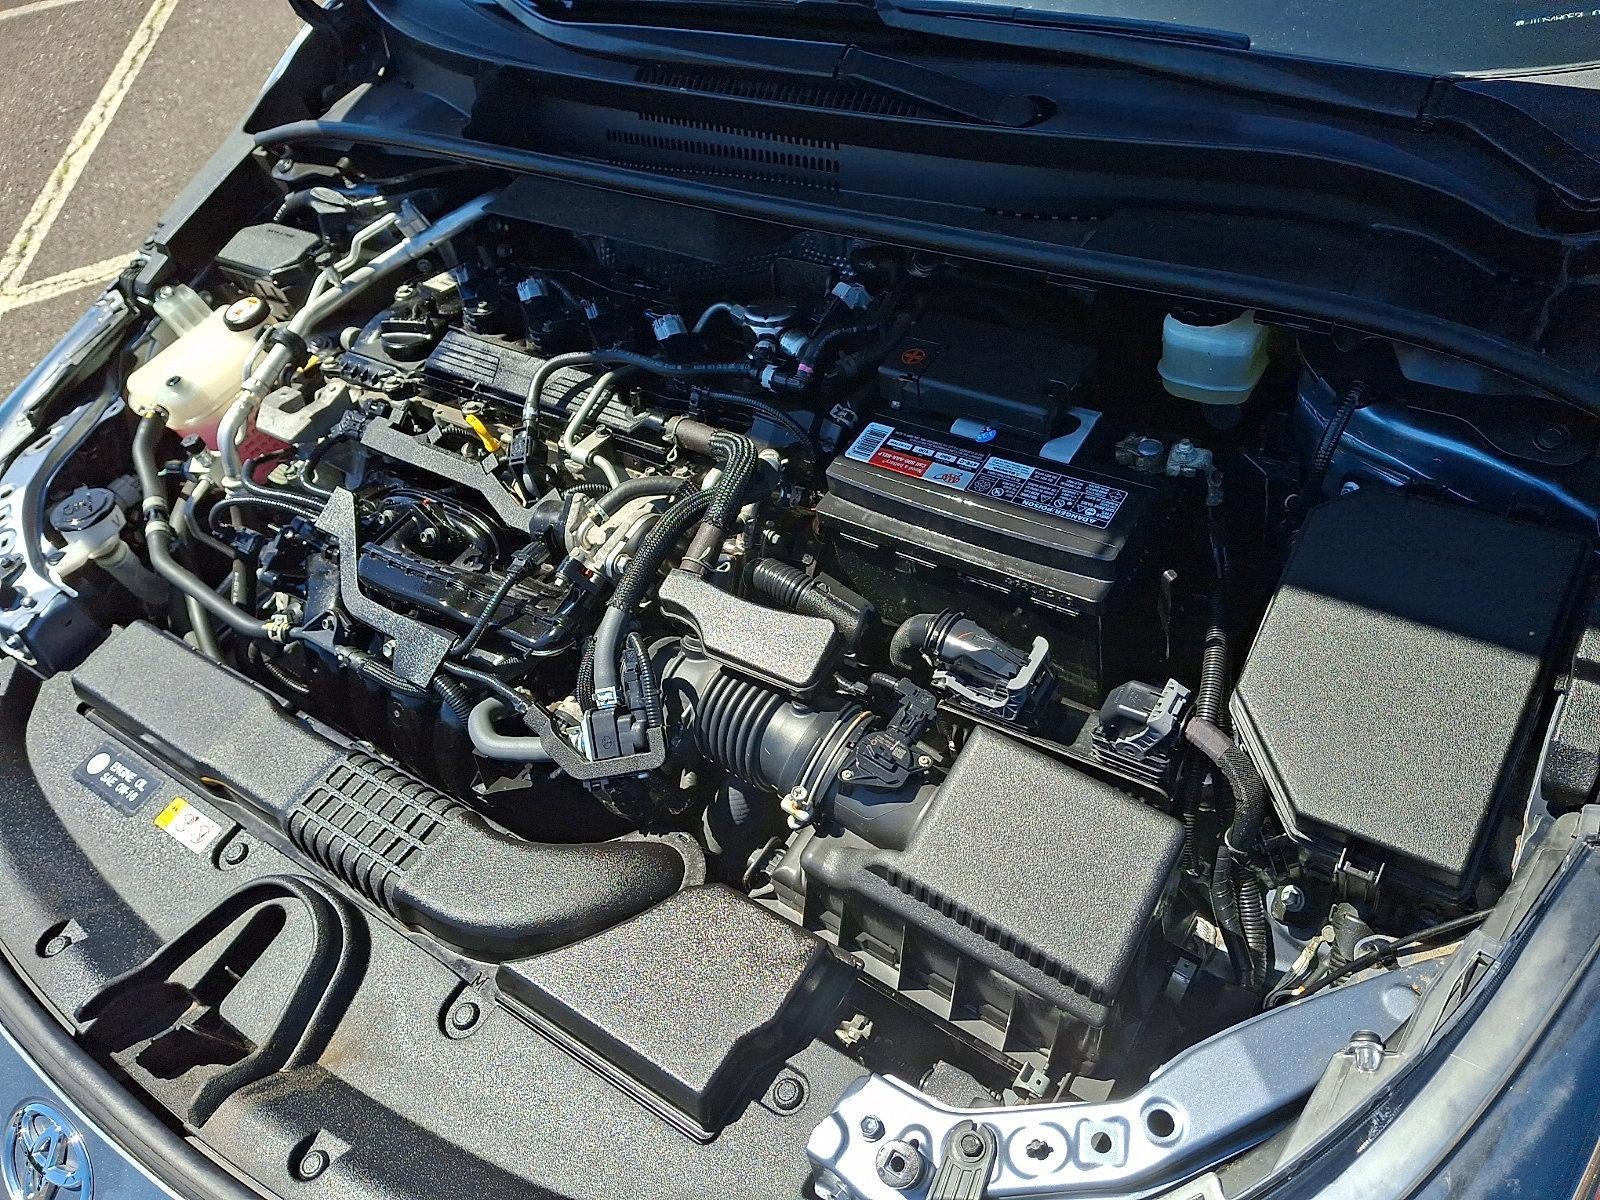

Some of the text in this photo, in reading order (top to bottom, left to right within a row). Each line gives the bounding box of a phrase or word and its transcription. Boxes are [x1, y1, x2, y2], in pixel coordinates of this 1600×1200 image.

[1020, 498, 1090, 522] DANGER/POISON
[99, 772, 118, 788] SAE
[110, 761, 148, 792] ENGINE OIL
